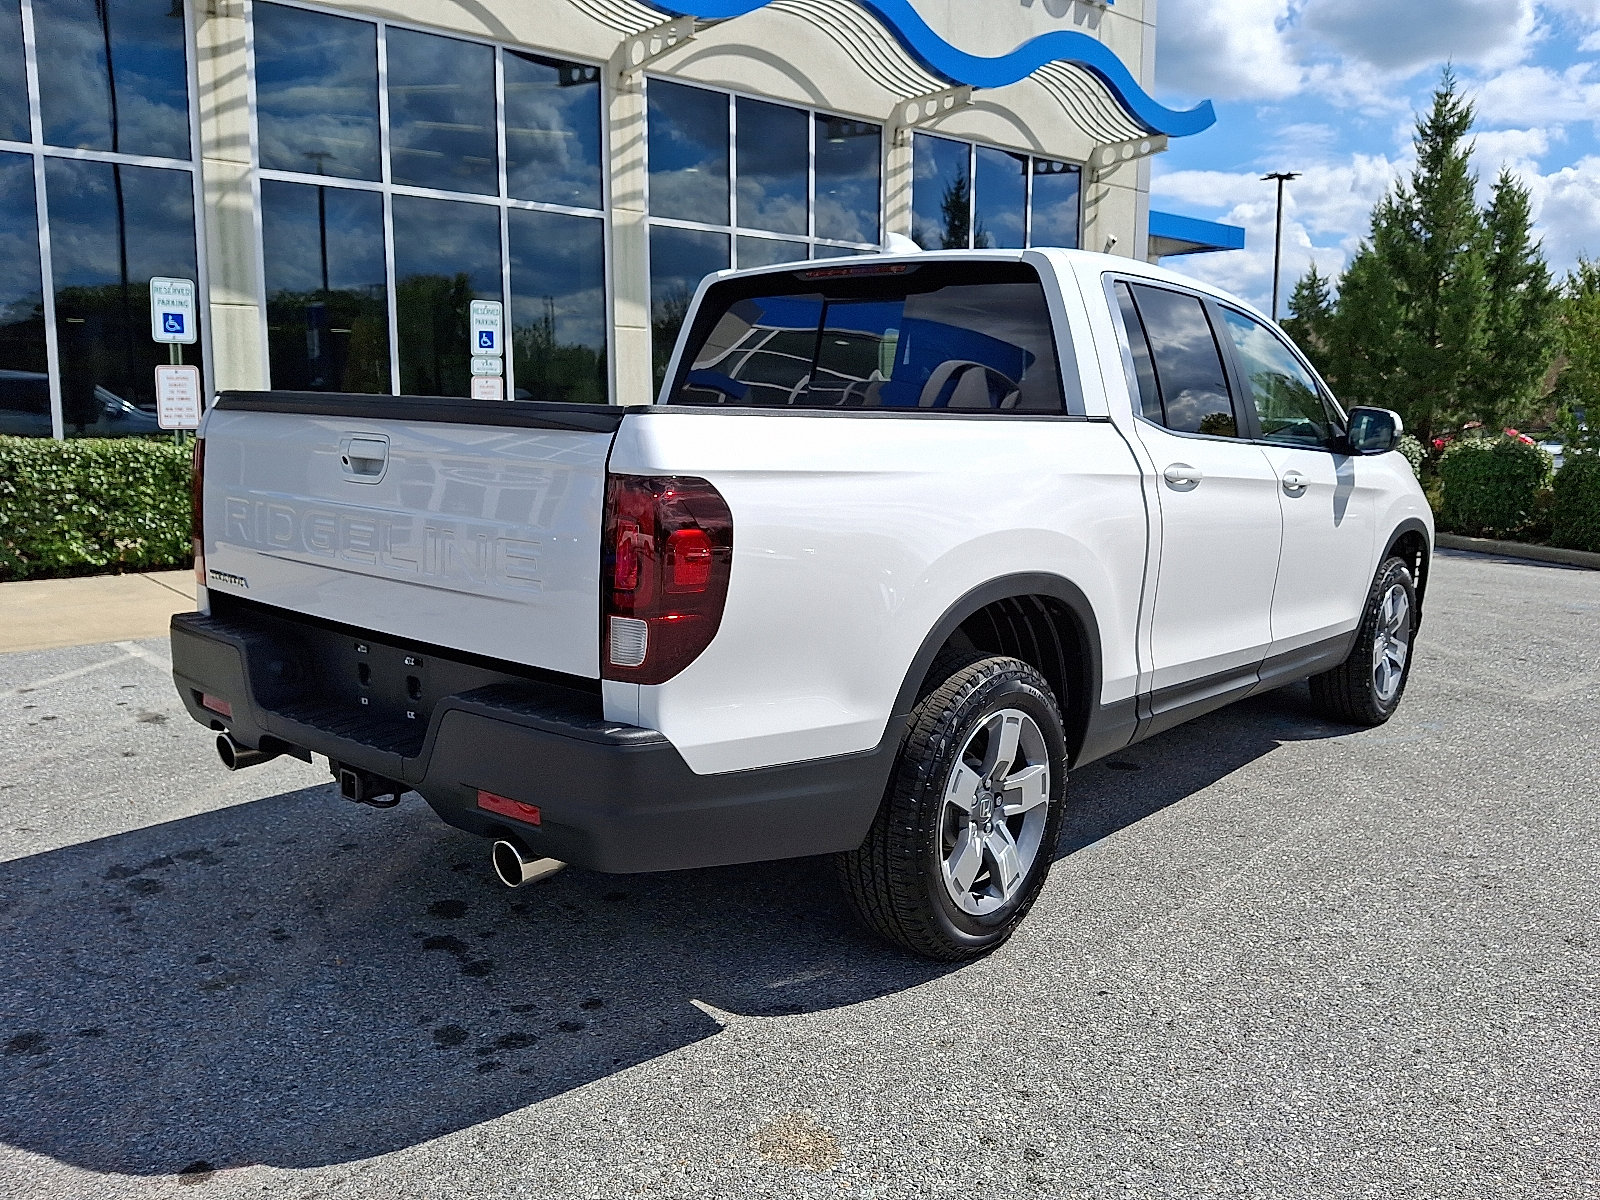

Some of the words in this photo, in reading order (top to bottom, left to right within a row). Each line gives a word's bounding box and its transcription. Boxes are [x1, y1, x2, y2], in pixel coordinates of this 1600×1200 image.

[153, 286, 191, 297] RESERVED
[157, 299, 189, 308] PARKING
[223, 496, 544, 594] RIDGELINE
[209, 568, 249, 589] HONDA
